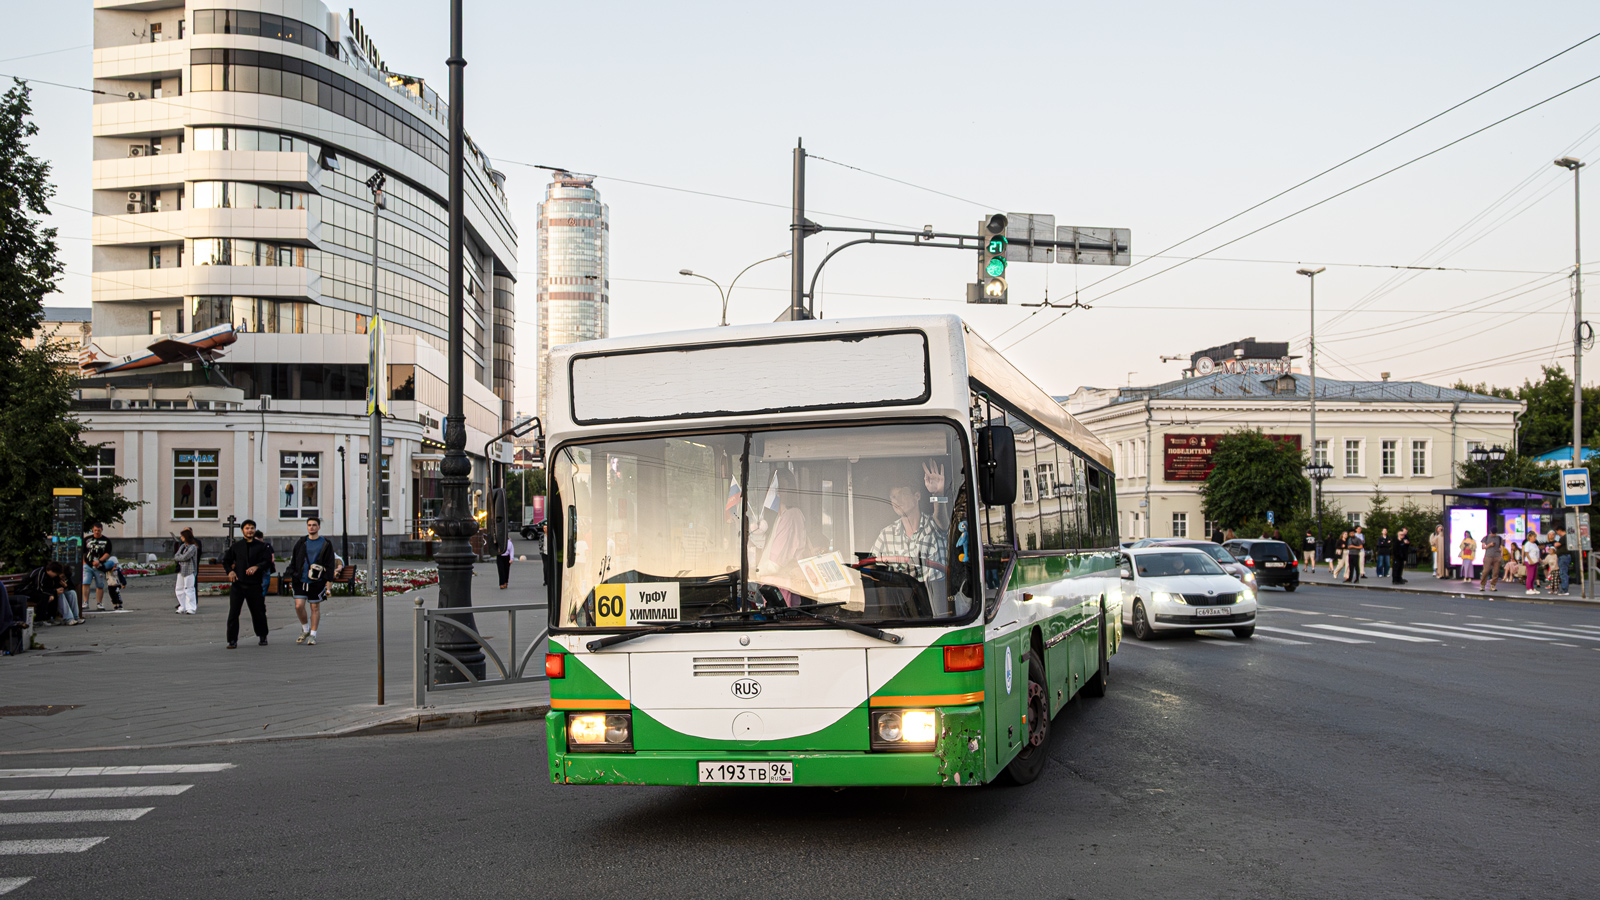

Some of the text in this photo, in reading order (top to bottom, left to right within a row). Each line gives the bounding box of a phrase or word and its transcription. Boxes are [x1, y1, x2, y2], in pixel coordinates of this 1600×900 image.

[989, 240, 1003, 253] 27
[1222, 356, 1292, 374] МУЗЕЙ
[178, 454, 216, 463] ЕРМАК
[639, 590, 667, 604] УрФУ
[597, 595, 624, 618] 60
[629, 608, 678, 620] ХИММАШ
[735, 682, 759, 695] RUS
[771, 764, 787, 776] 96
